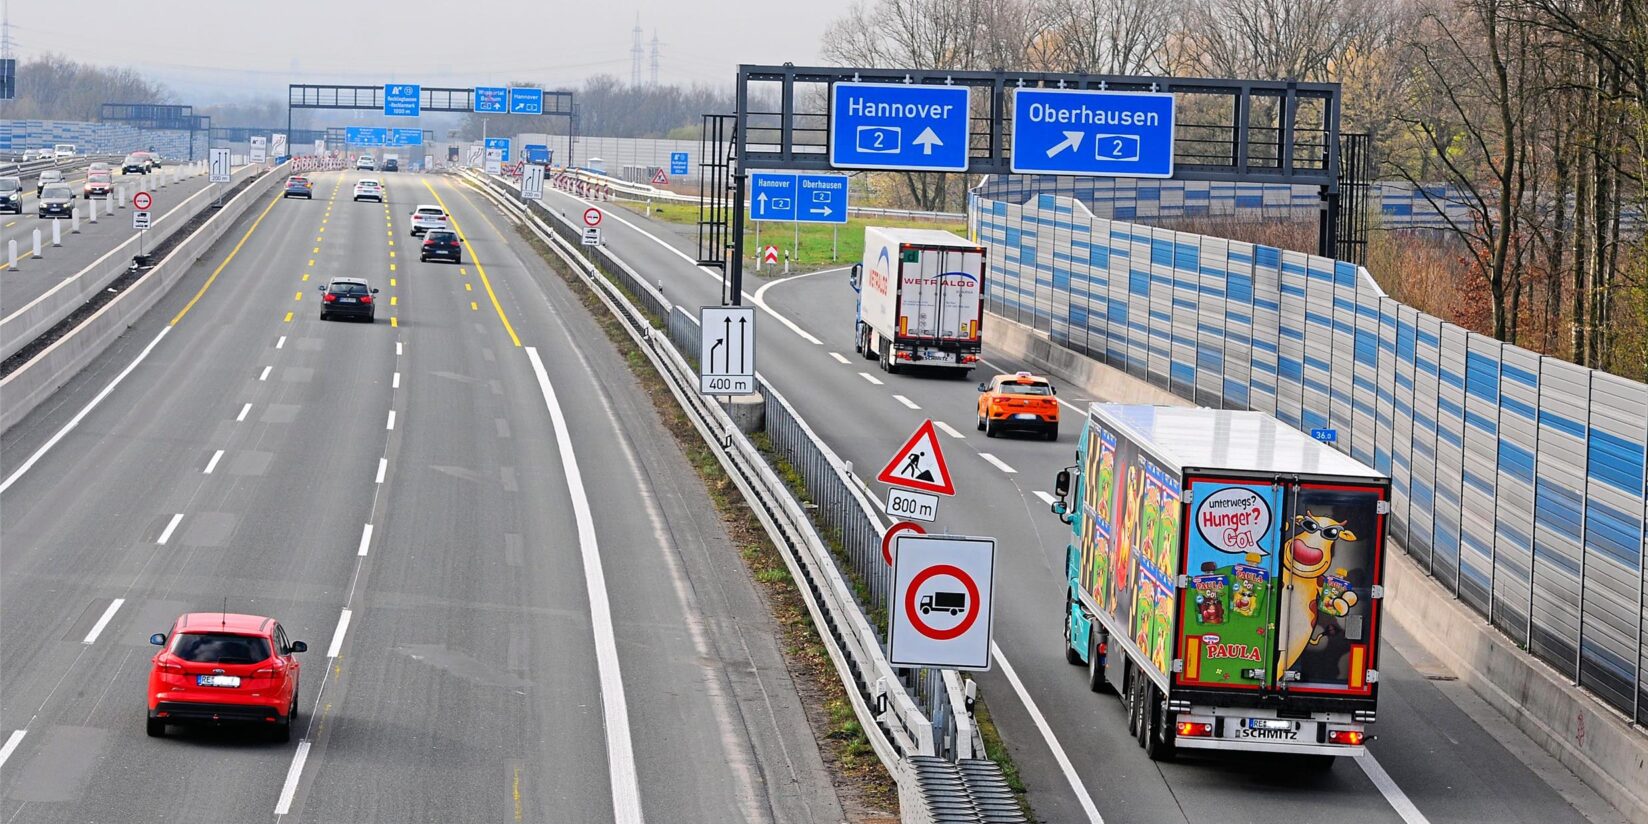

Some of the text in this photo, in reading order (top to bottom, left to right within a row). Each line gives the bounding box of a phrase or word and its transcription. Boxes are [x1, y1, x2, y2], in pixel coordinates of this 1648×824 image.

[848, 97, 953, 120] Hannover
[1029, 103, 1160, 127] Oberhausen
[874, 132, 884, 148] 2
[1113, 140, 1122, 156] 2
[758, 178, 790, 188] Hannover
[802, 180, 842, 189] Oberhausen
[904, 278, 975, 287] WETRALOG
[709, 379, 747, 390] 400 m
[892, 497, 932, 516] 800 m
[1209, 496, 1256, 510] unterwegs?
[1203, 508, 1261, 532] Hunger?
[1207, 644, 1261, 661] PAULA
[1242, 729, 1297, 740] SCHMITZ
